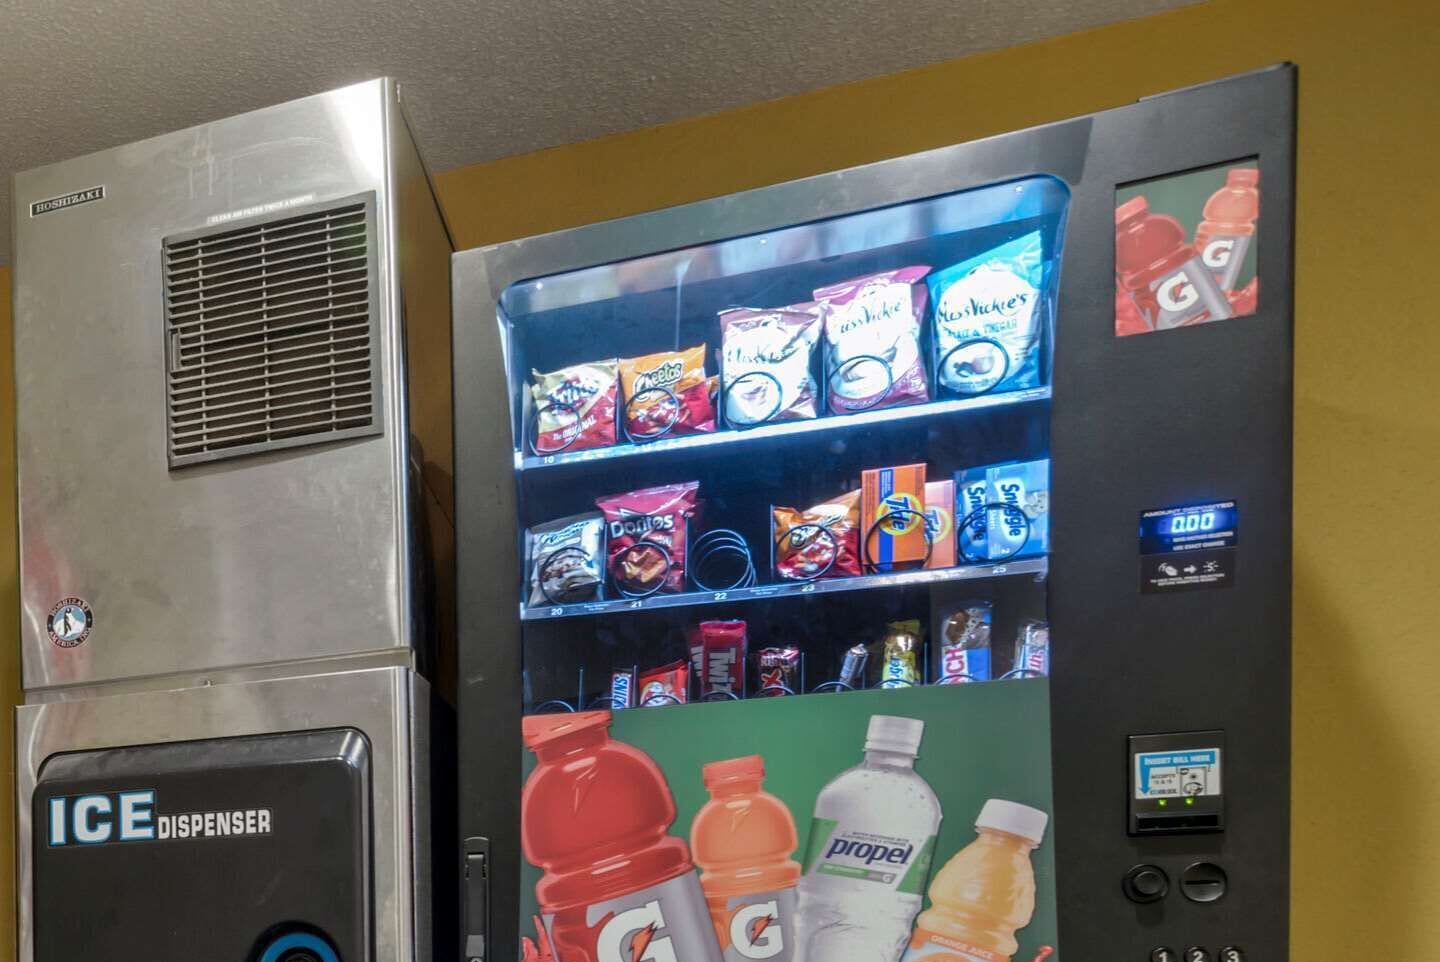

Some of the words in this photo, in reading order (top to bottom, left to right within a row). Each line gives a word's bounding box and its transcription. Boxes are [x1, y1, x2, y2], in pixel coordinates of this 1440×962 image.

[35, 189, 101, 213] HOSHIZAKI
[1202, 240, 1234, 268] G
[1157, 271, 1199, 312] G
[611, 514, 674, 538] Doritos
[714, 592, 727, 600] 22
[49, 790, 155, 846] ICE
[158, 809, 271, 840] DISPENSER
[825, 838, 913, 865] propel
[730, 900, 785, 959] G
